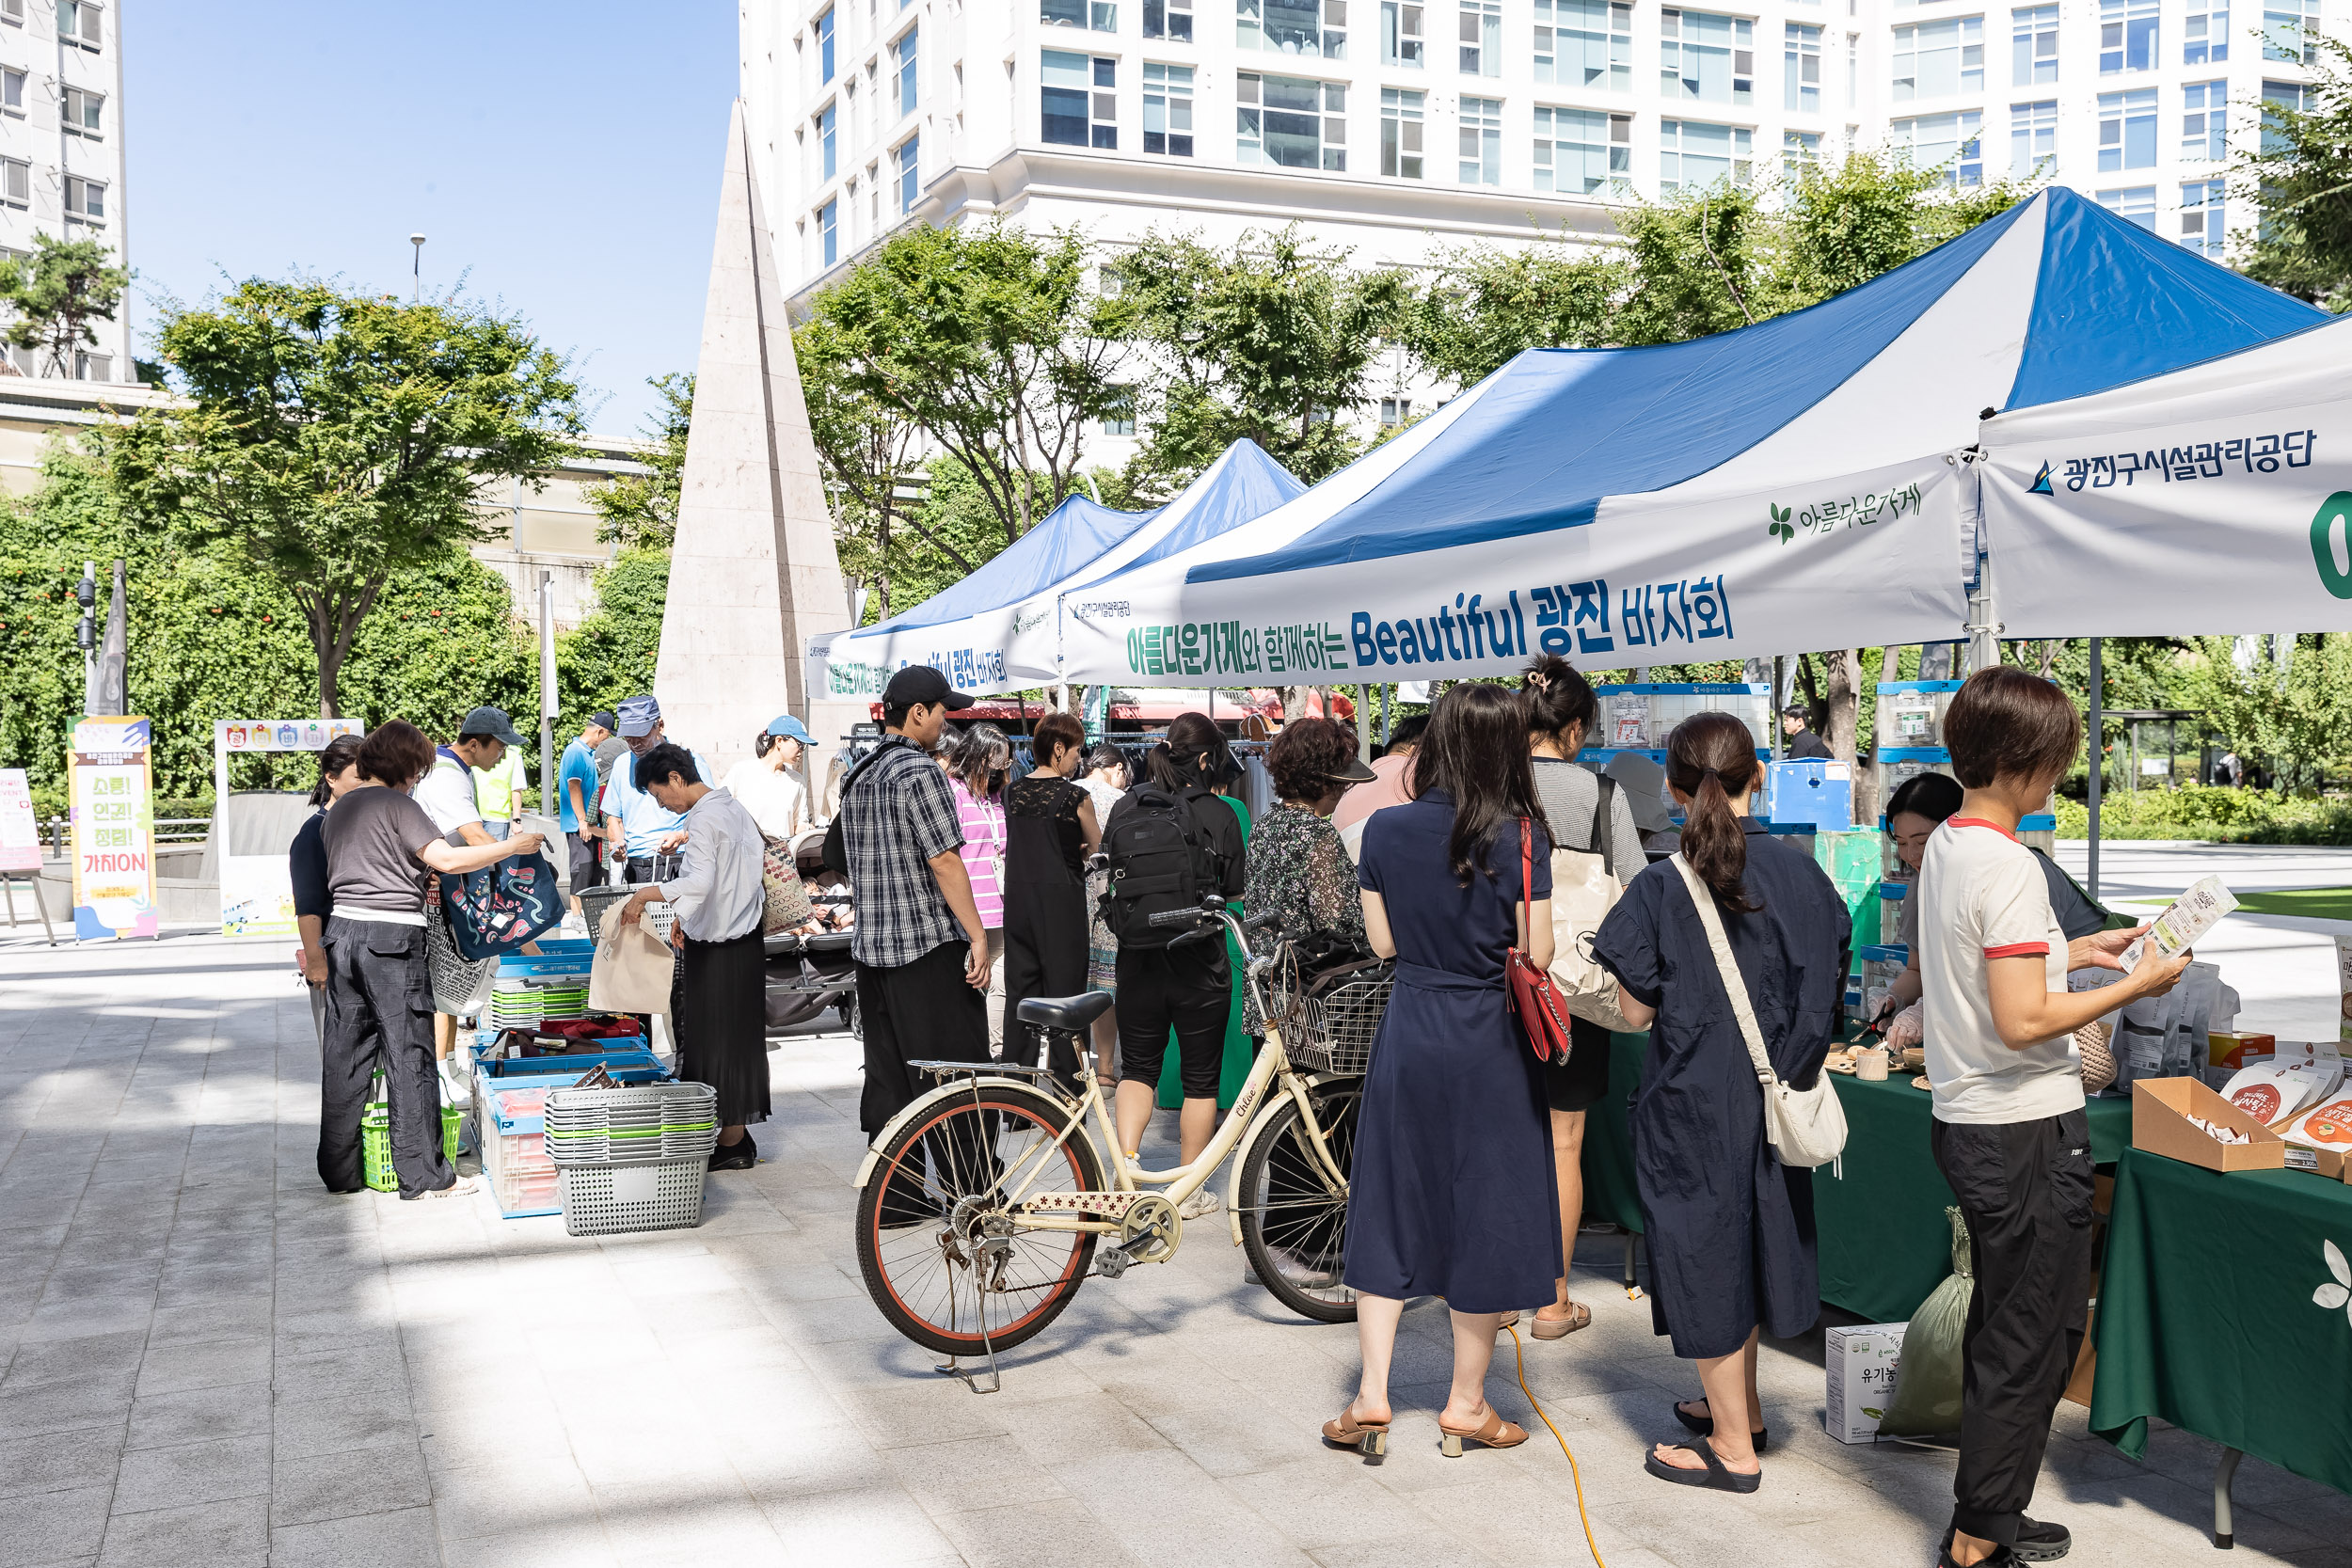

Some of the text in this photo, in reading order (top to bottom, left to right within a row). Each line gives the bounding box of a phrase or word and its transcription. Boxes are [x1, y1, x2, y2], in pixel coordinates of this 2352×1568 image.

[2063, 429, 2317, 493] 광진구시설관리공단
[1800, 483, 1921, 535] 아름다운가게
[1081, 601, 1131, 619] 광진구시설관리공단
[1127, 574, 1734, 675] 아름다운가게와 함께하는 Beautiful 광진 바자회
[953, 647, 977, 689] 광진
[976, 648, 1008, 685] 바자회
[93, 776, 131, 795] 소통!
[93, 802, 132, 821] 인권!
[84, 853, 145, 873] 가치ON
